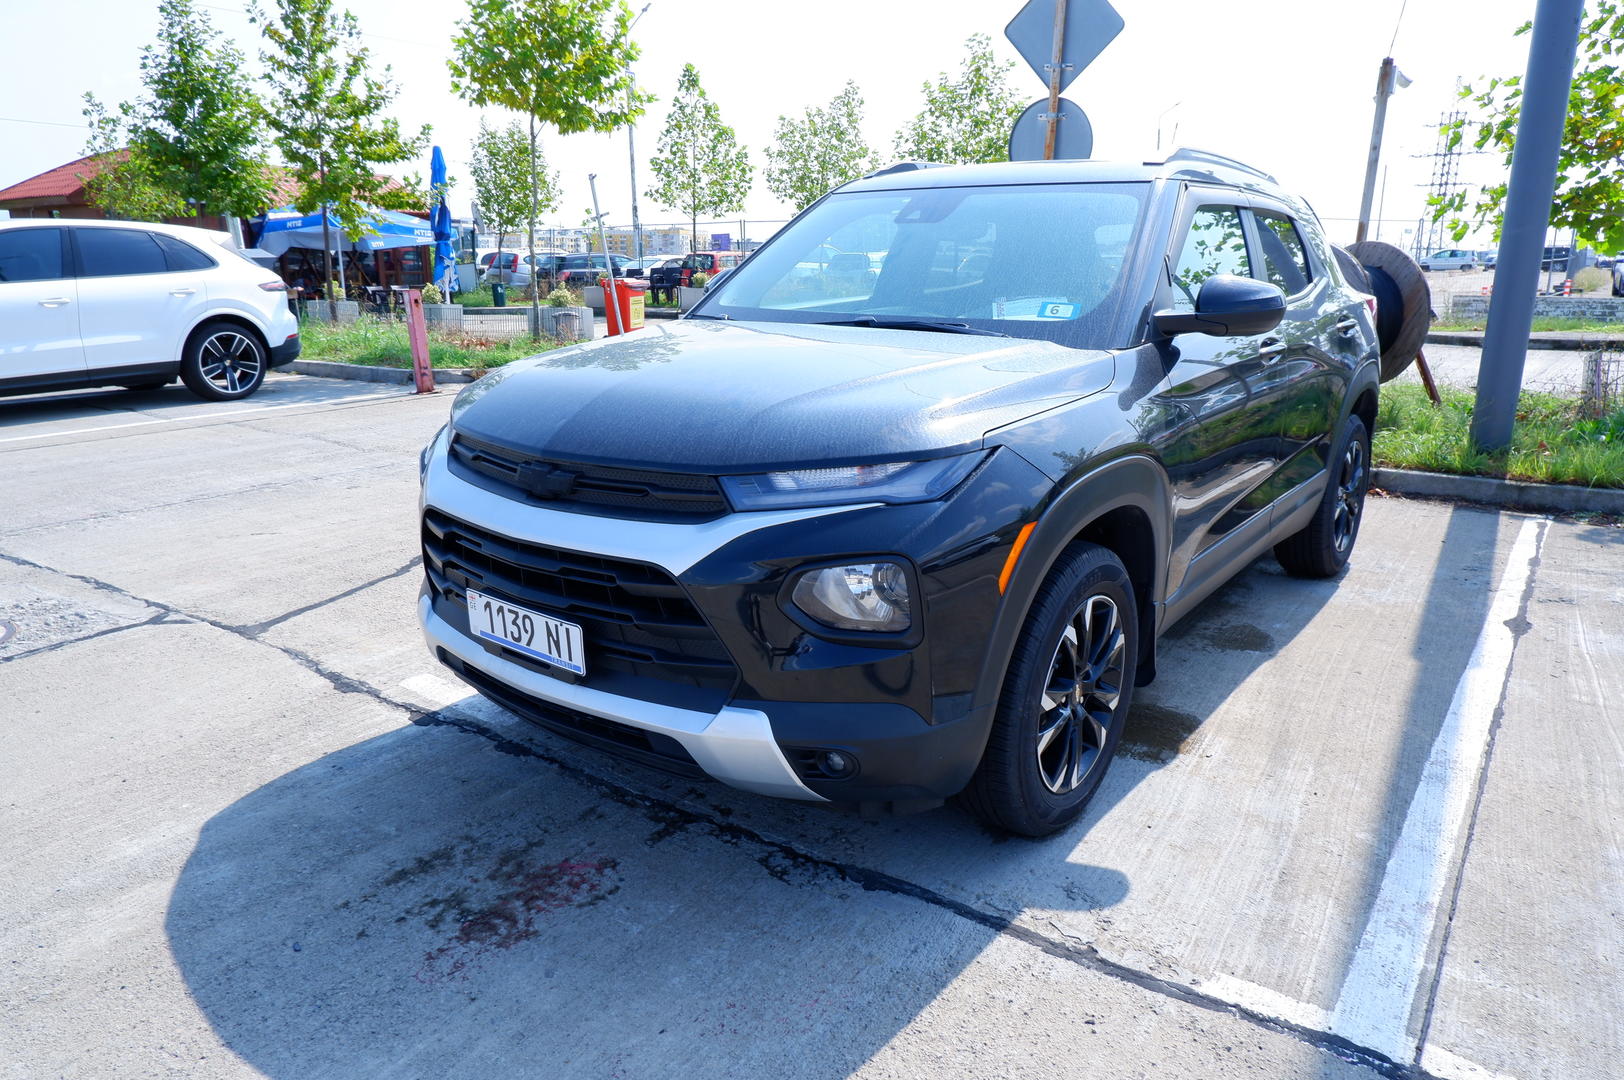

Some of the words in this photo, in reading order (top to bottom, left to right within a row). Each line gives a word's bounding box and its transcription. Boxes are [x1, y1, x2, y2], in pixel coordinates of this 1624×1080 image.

[1050, 305, 1060, 315] 6
[470, 601, 477, 610] GE
[484, 601, 535, 647] 1139
[545, 621, 573, 662] NI
